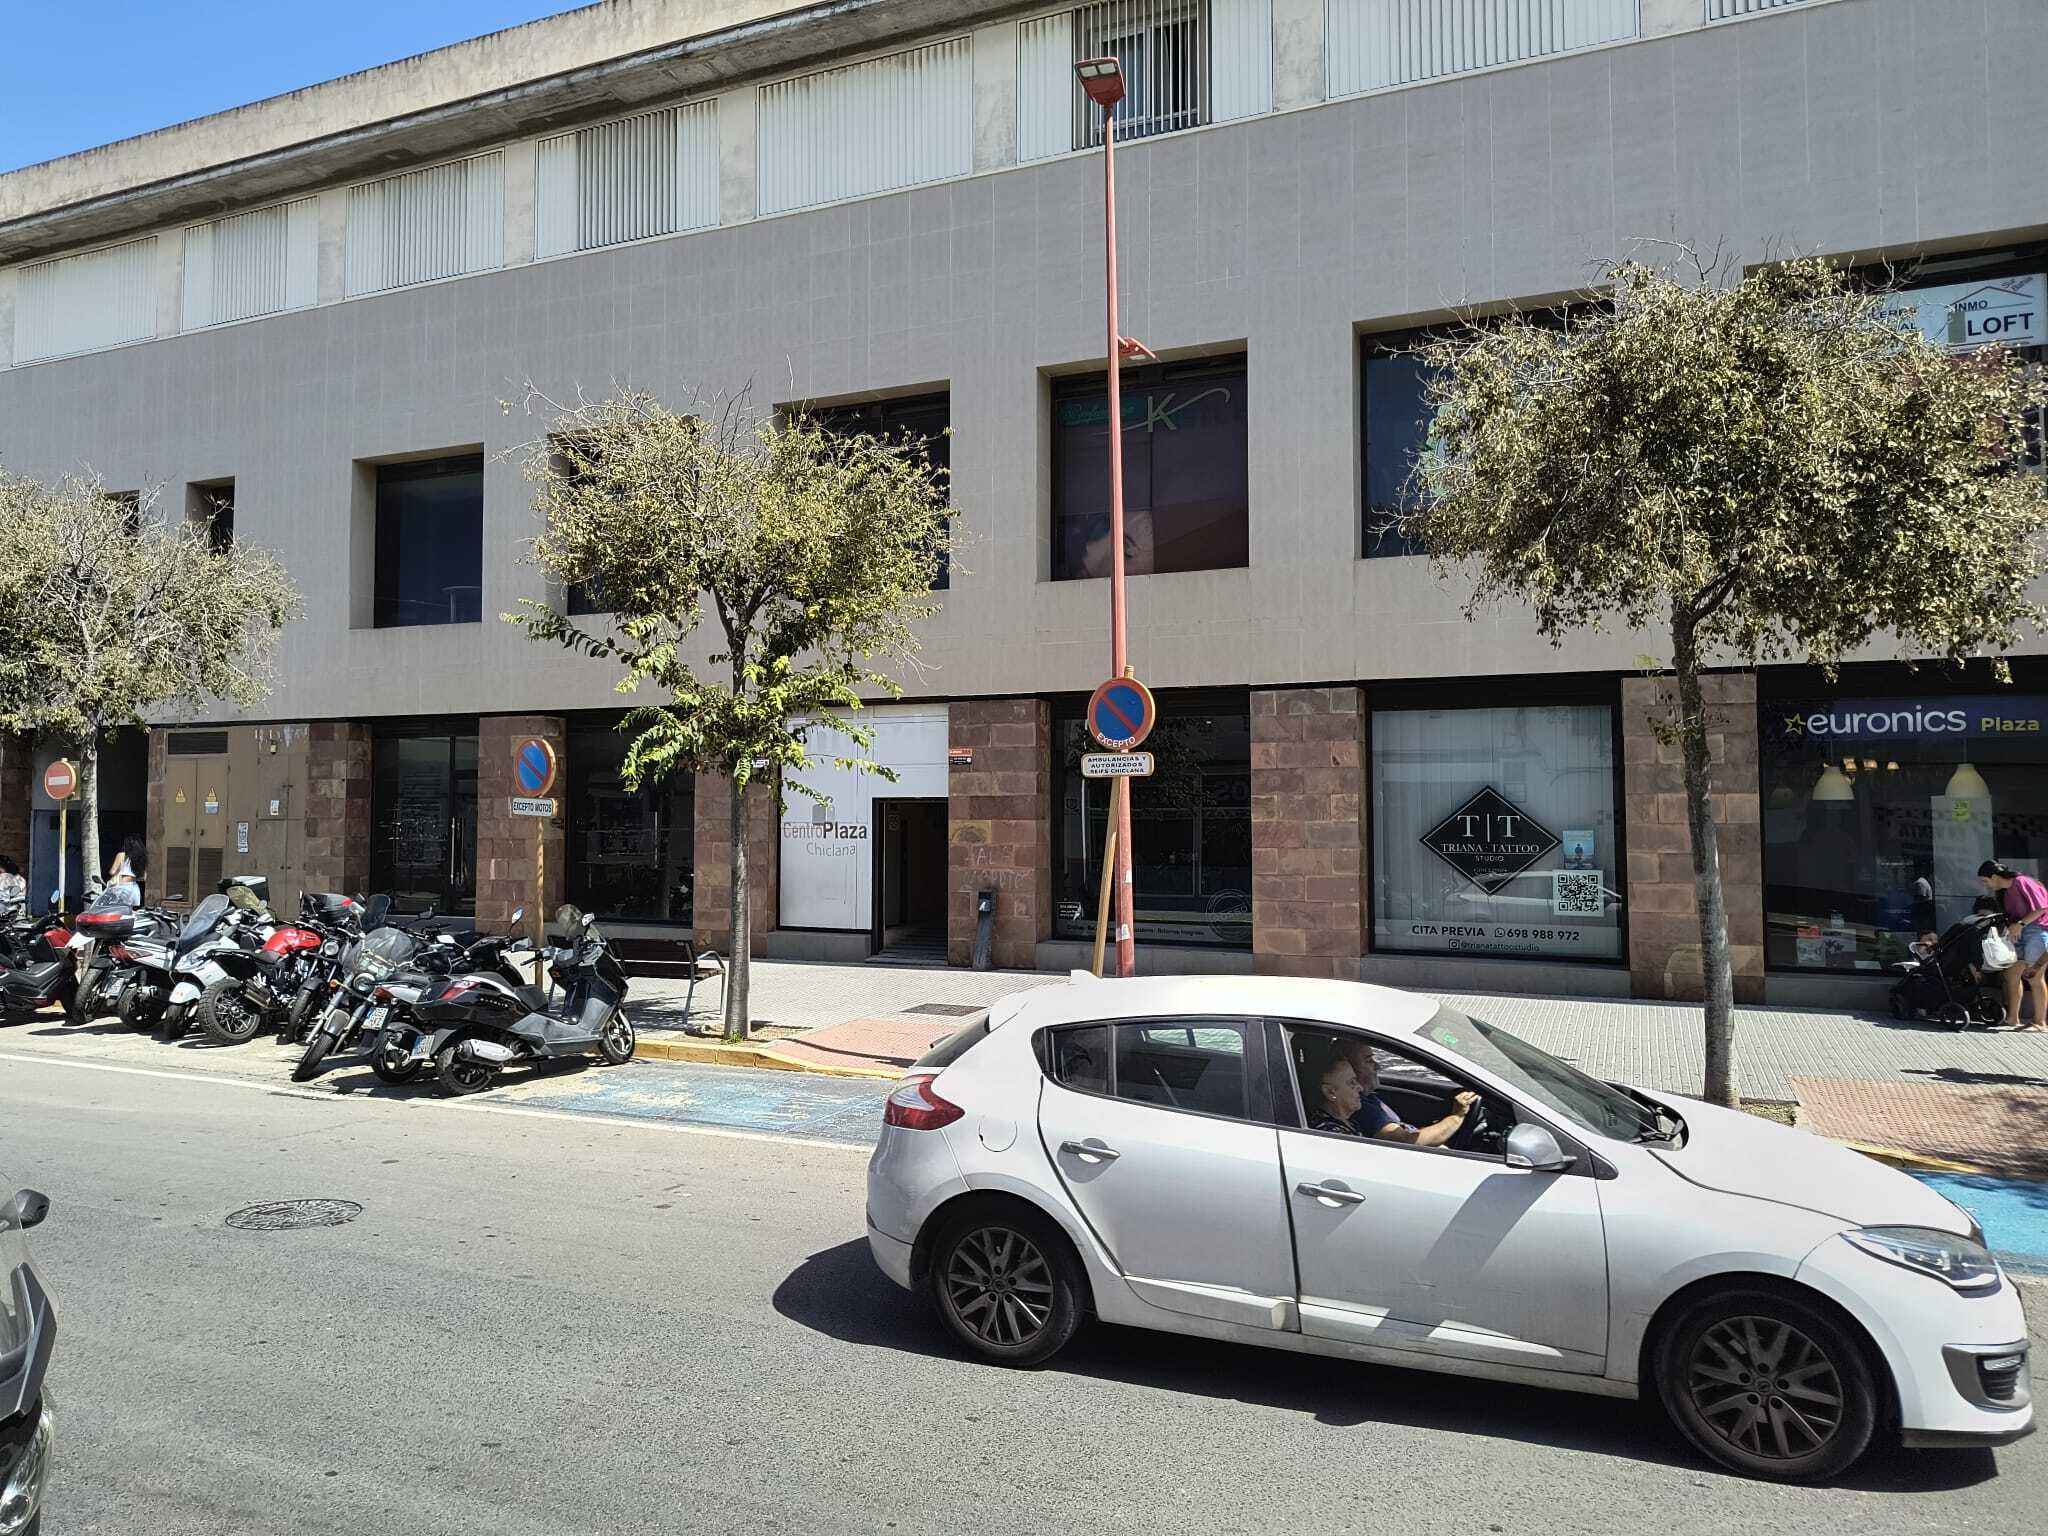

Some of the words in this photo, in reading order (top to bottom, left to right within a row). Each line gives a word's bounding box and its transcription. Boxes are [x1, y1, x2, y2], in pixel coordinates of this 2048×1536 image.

[1954, 300, 1988, 312] INMO
[1967, 312, 2035, 337] LOFT
[1806, 704, 1968, 735] euronics
[1981, 716, 2041, 732] Plaza
[1097, 731, 1136, 748] EXCEPTO
[513, 801, 534, 811] EXCEPTO
[535, 803, 552, 813] MOTOS
[806, 842, 856, 857] Chiclana
[1440, 843, 1483, 853] TRIANA
[1492, 844, 1540, 854] TATTOO
[1411, 924, 1438, 936] CITA
[1441, 926, 1486, 937] PREVIA
[1507, 928, 1529, 939] 698
[1532, 929, 1554, 940] 988
[1557, 930, 1581, 942] 972
